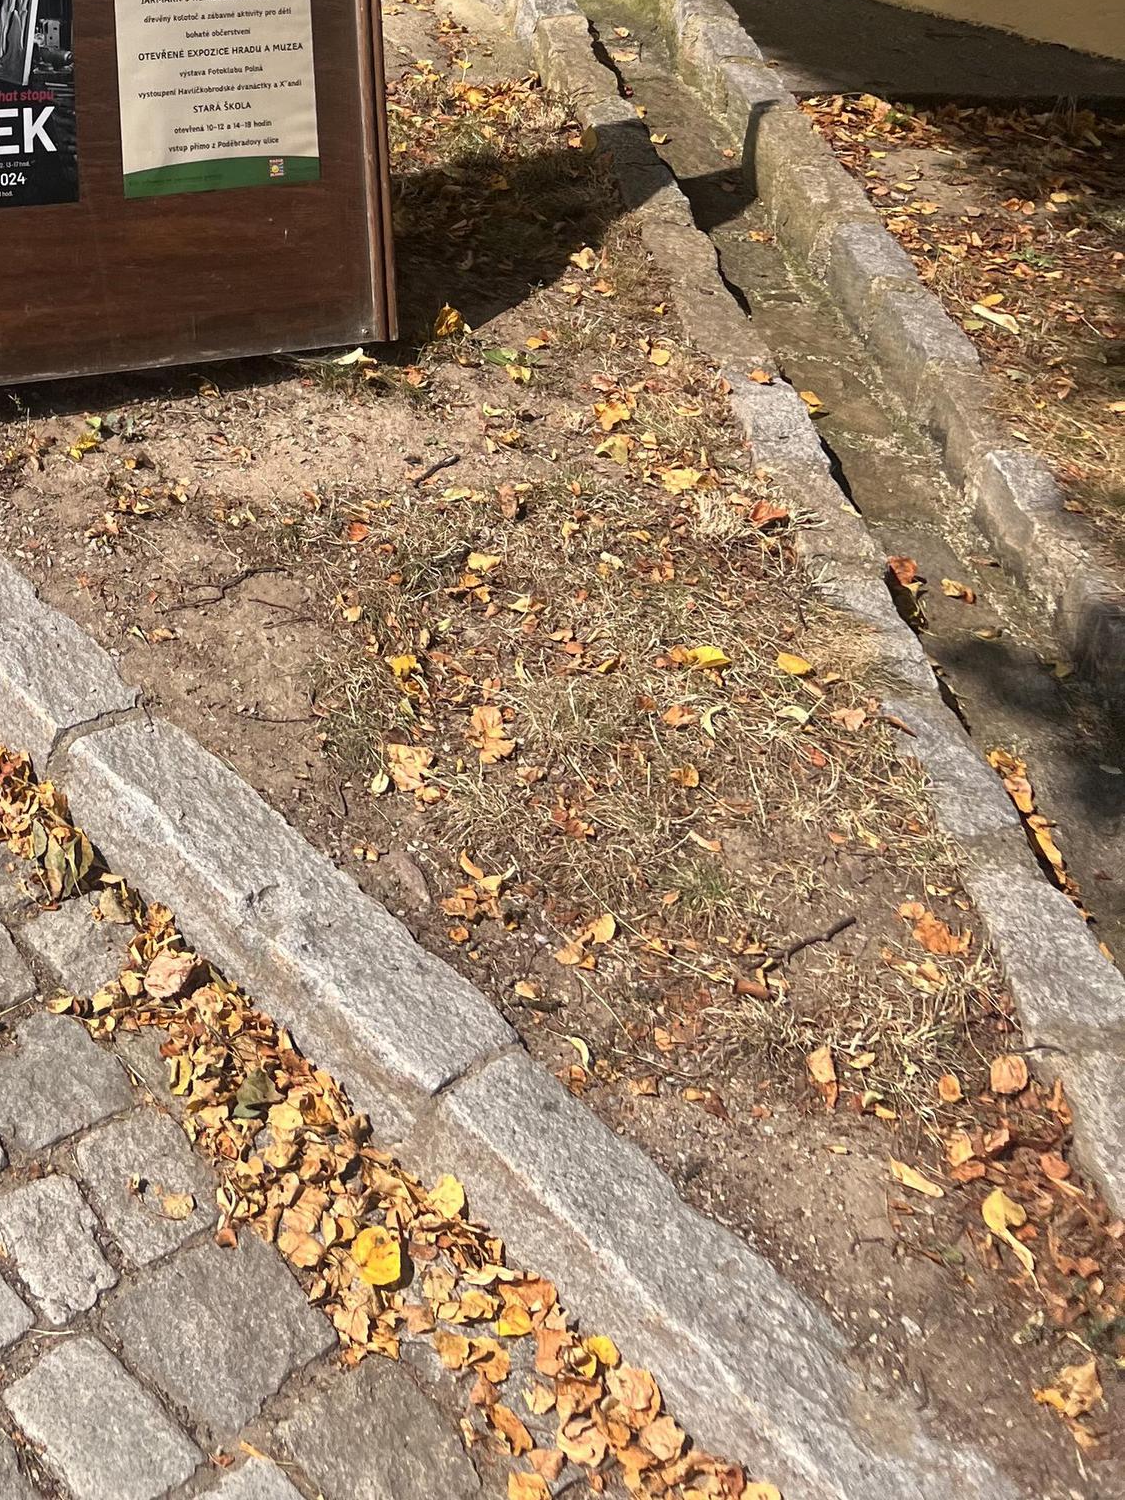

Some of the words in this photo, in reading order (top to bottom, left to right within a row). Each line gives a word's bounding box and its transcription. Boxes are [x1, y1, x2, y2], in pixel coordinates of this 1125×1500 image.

[174, 13, 198, 21] kolotoč
[237, 10, 262, 18] aktivity
[186, 30, 209, 38] bohaté
[138, 49, 184, 61] OTEVŘENÉ
[188, 47, 229, 57] EXPOZICE
[232, 46, 261, 54] HRADU
[273, 42, 303, 51] MUZEA
[21, 89, 55, 102] stopu
[193, 103, 221, 113] STARÁ
[224, 101, 251, 111] ŠKOLA
[254, 119, 272, 127] hodin
[168, 143, 188, 153] vstup
[263, 137, 279, 145] ulice
